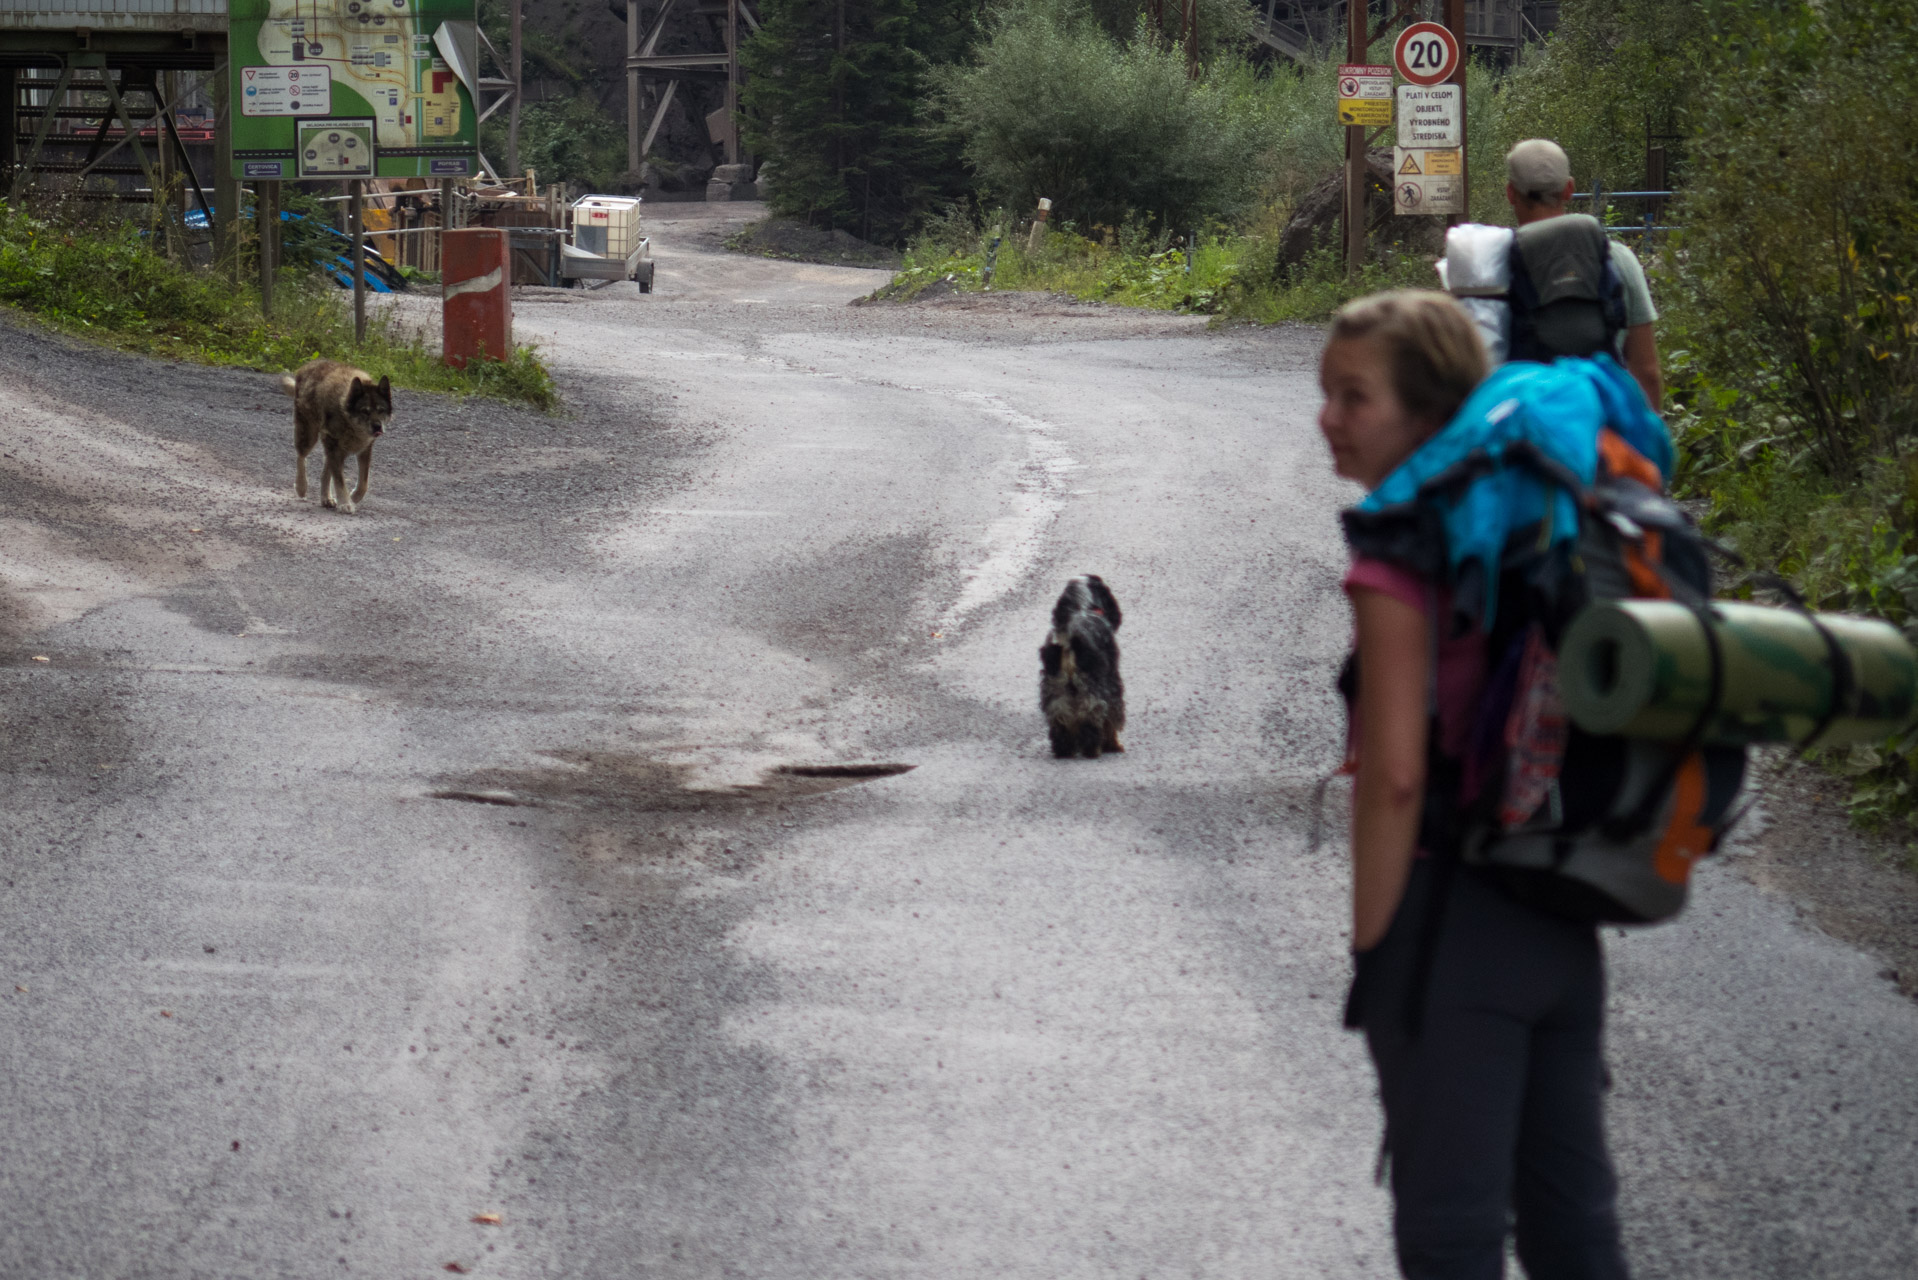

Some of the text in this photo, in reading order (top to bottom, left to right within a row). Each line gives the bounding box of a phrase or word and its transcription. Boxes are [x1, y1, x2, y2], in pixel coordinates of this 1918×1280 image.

[1410, 40, 1442, 69] 20
[1405, 90, 1423, 99] PLATÍ
[1431, 91, 1453, 99] CELOM
[1415, 105, 1443, 113] OBJEKTE
[1412, 132, 1447, 140] STREDISKA
